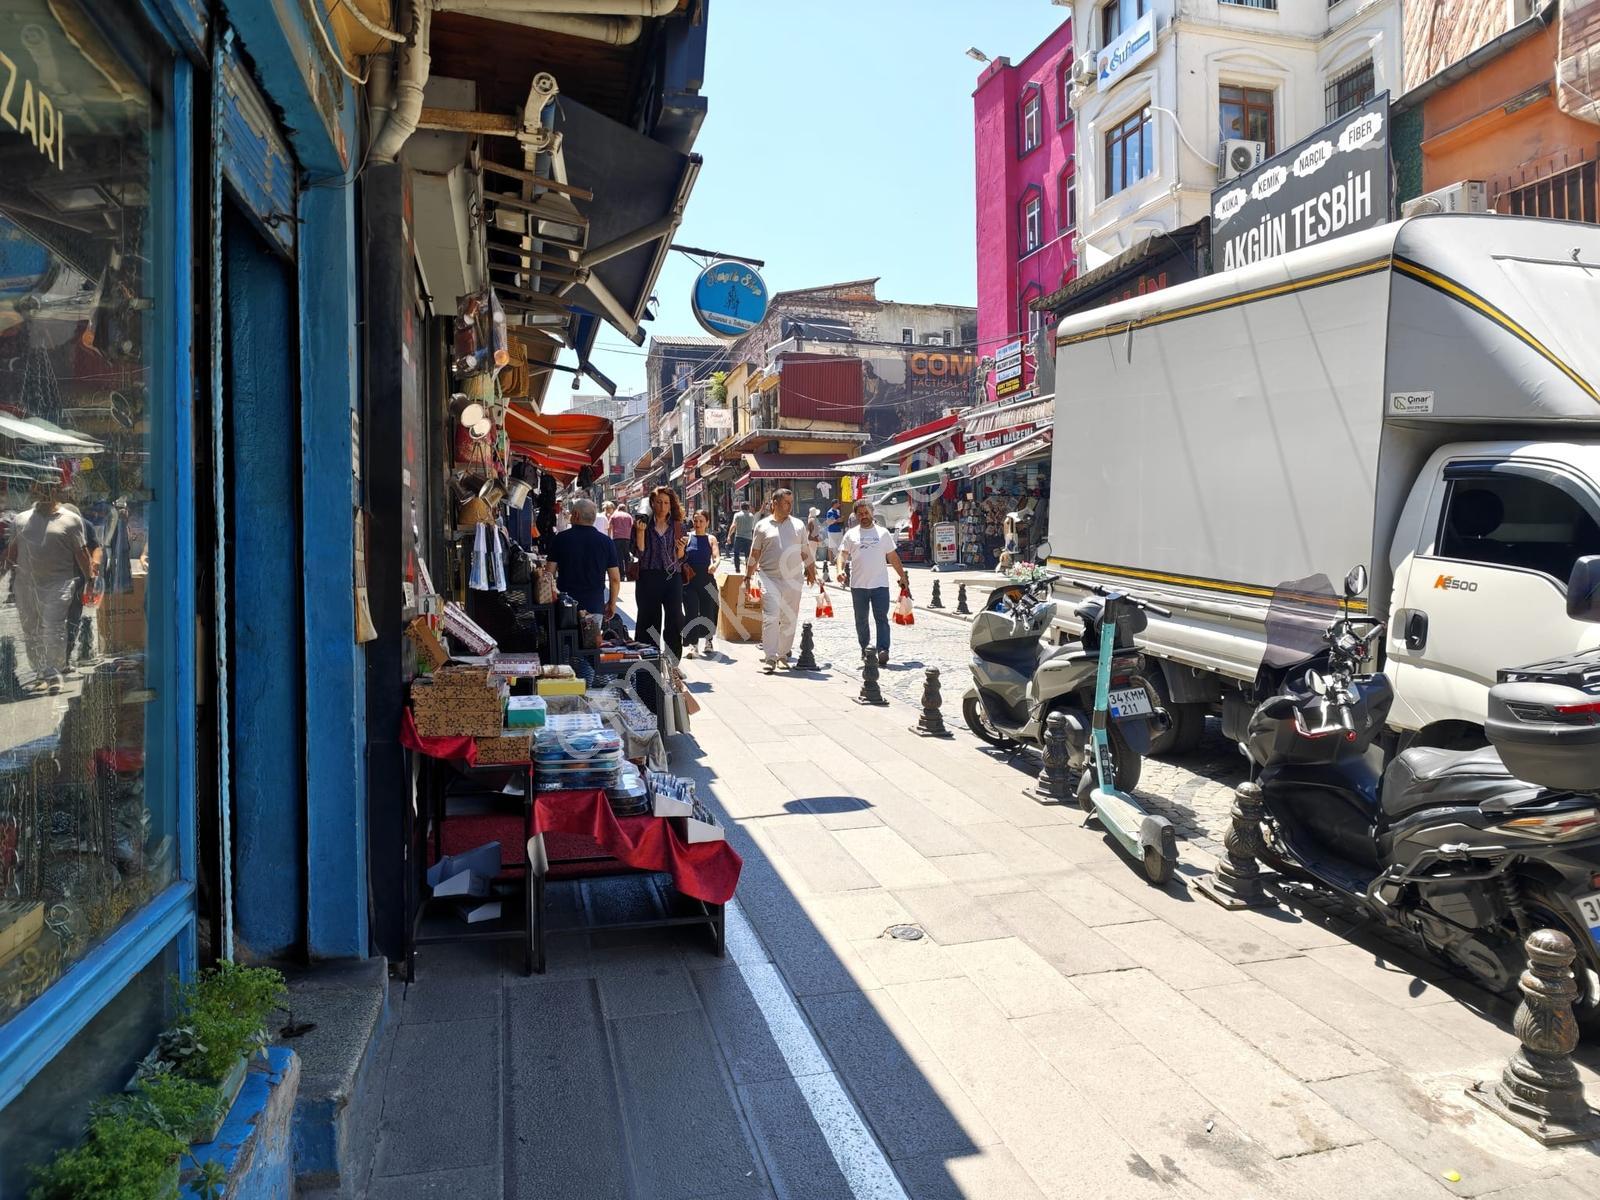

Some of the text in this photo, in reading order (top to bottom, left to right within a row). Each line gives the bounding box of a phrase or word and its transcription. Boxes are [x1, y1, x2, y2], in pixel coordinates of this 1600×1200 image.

[1221, 120, 1372, 214] KUKA KEMİK NARÇIL FİBER
[1223, 170, 1371, 272] AKGÜN TESBİH
[911, 379, 957, 388] TACTICAL
[1109, 689, 1147, 705] 34 KMM
[1121, 703, 1139, 715] 211
[1583, 899, 1600, 922] 3
